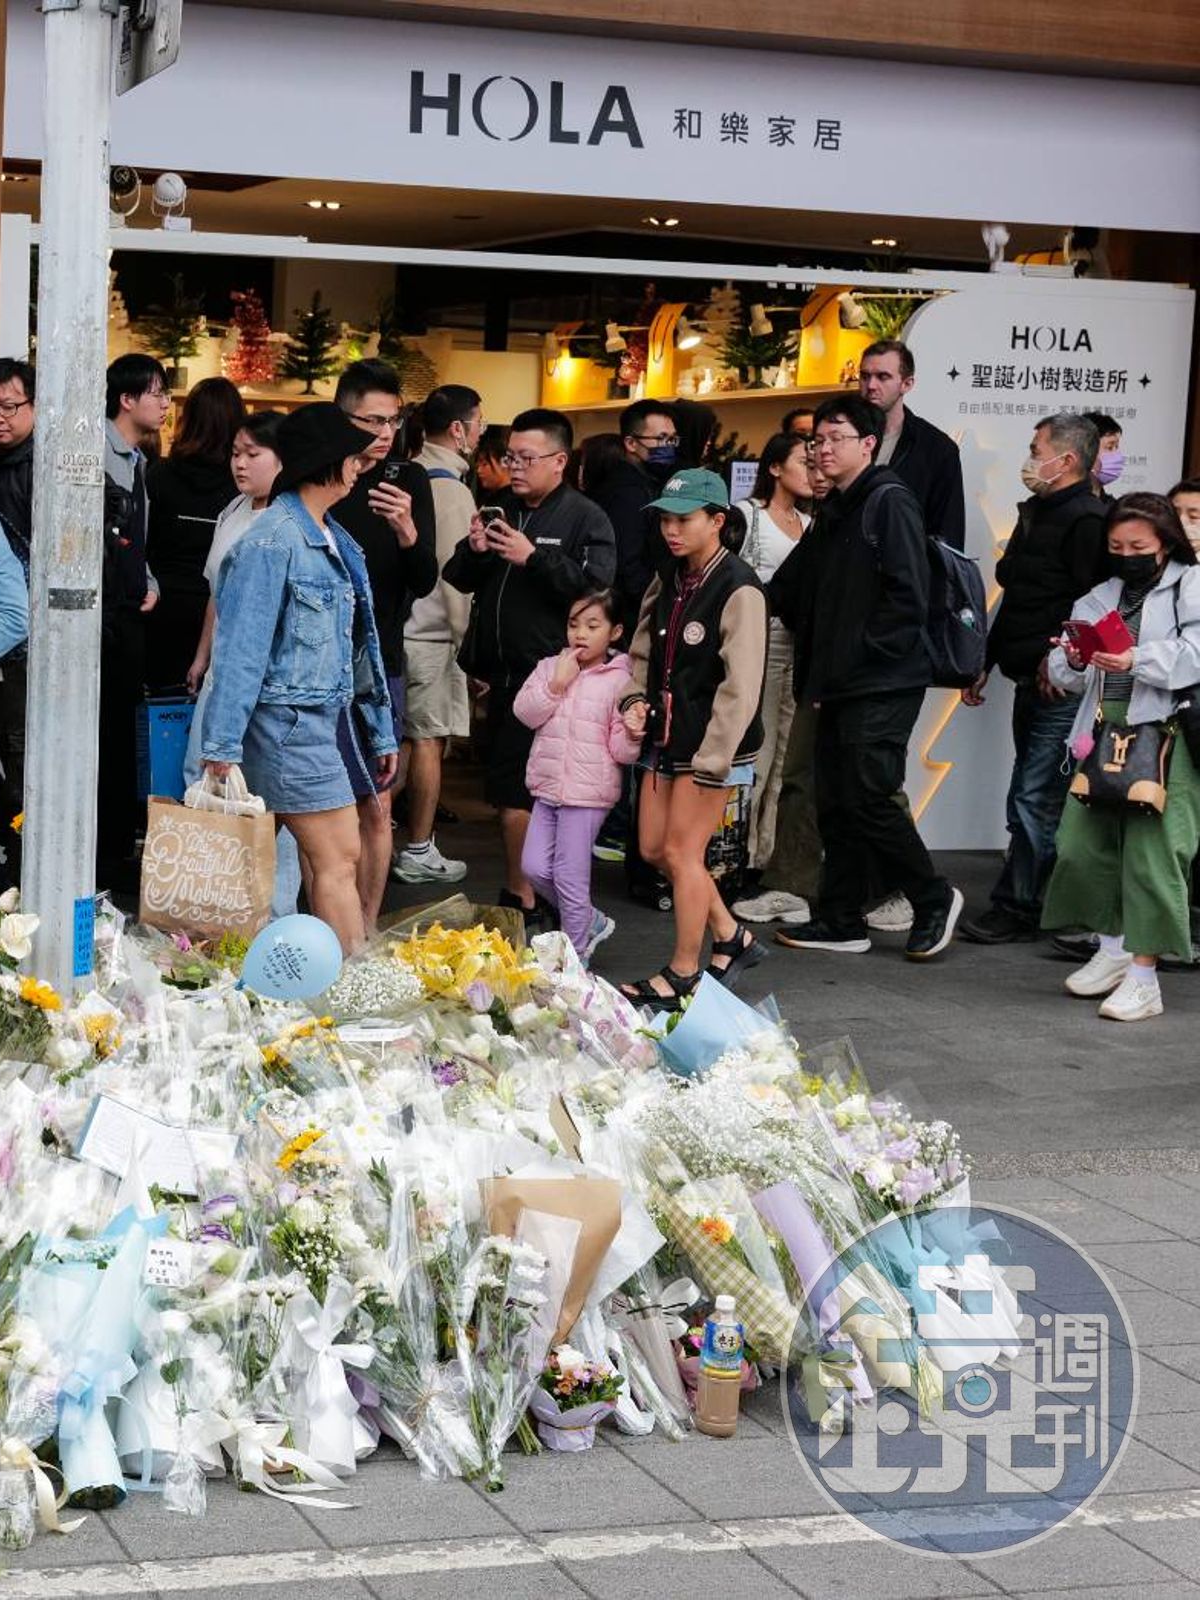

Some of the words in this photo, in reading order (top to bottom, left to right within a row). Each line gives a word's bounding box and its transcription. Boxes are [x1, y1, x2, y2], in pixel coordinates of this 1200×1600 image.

[409, 70, 644, 149] HOLA
[672, 107, 842, 152] 和樂家居
[1011, 325, 1093, 352] HOLA
[971, 364, 1128, 393] 聖誕小樹製造所
